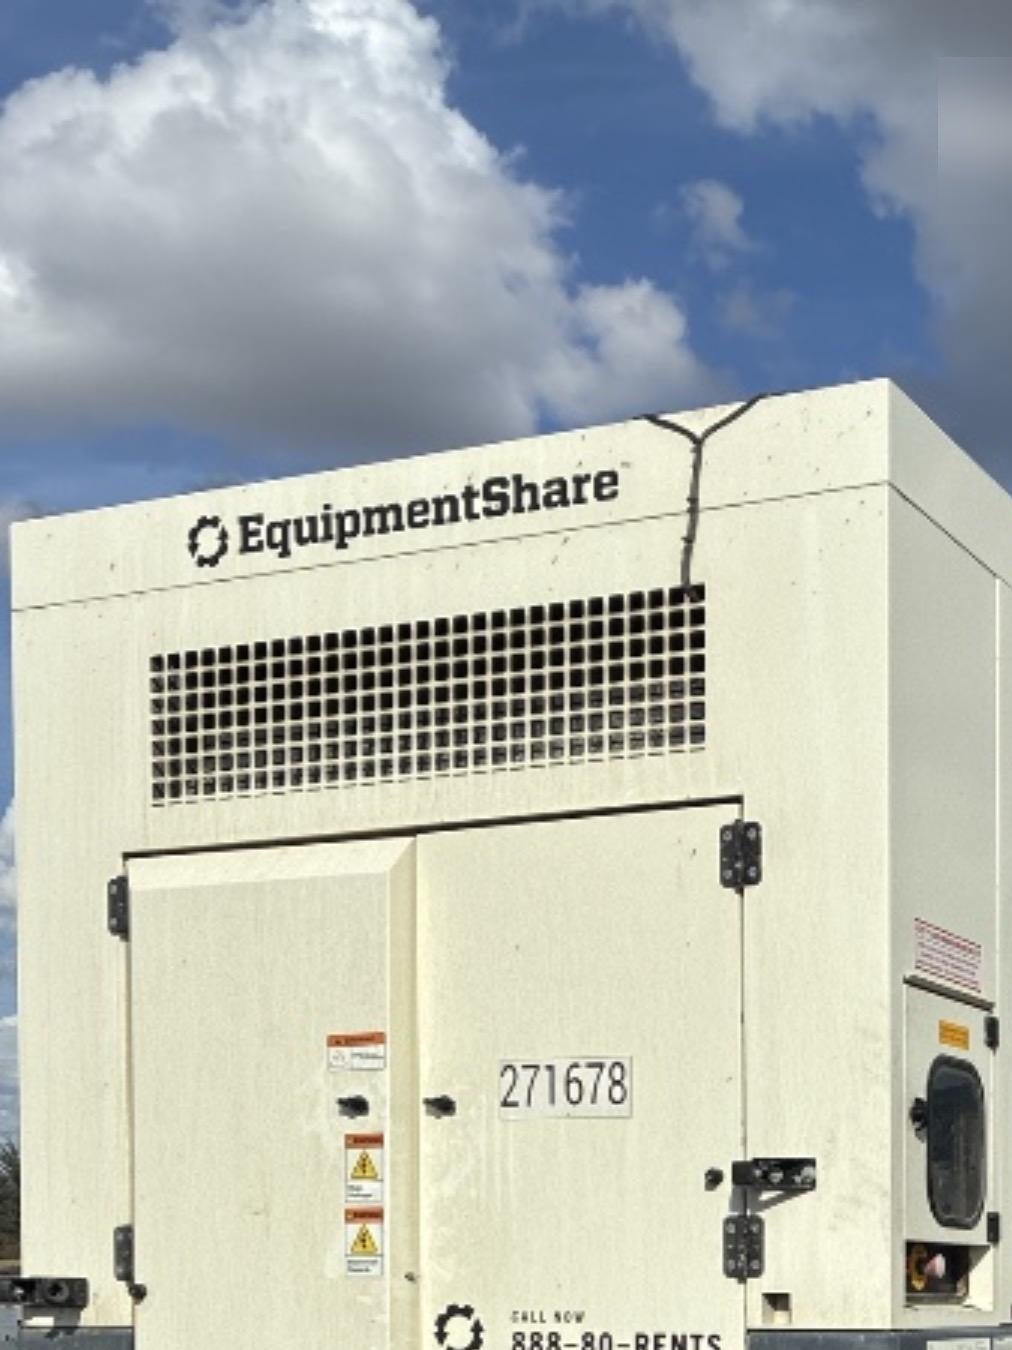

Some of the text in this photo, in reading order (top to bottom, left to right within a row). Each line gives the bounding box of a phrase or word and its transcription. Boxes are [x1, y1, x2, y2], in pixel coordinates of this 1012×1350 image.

[239, 469, 619, 558] EquipmentShare
[500, 1062, 627, 1107] 271678
[511, 1310, 586, 1324] CALL NOW
